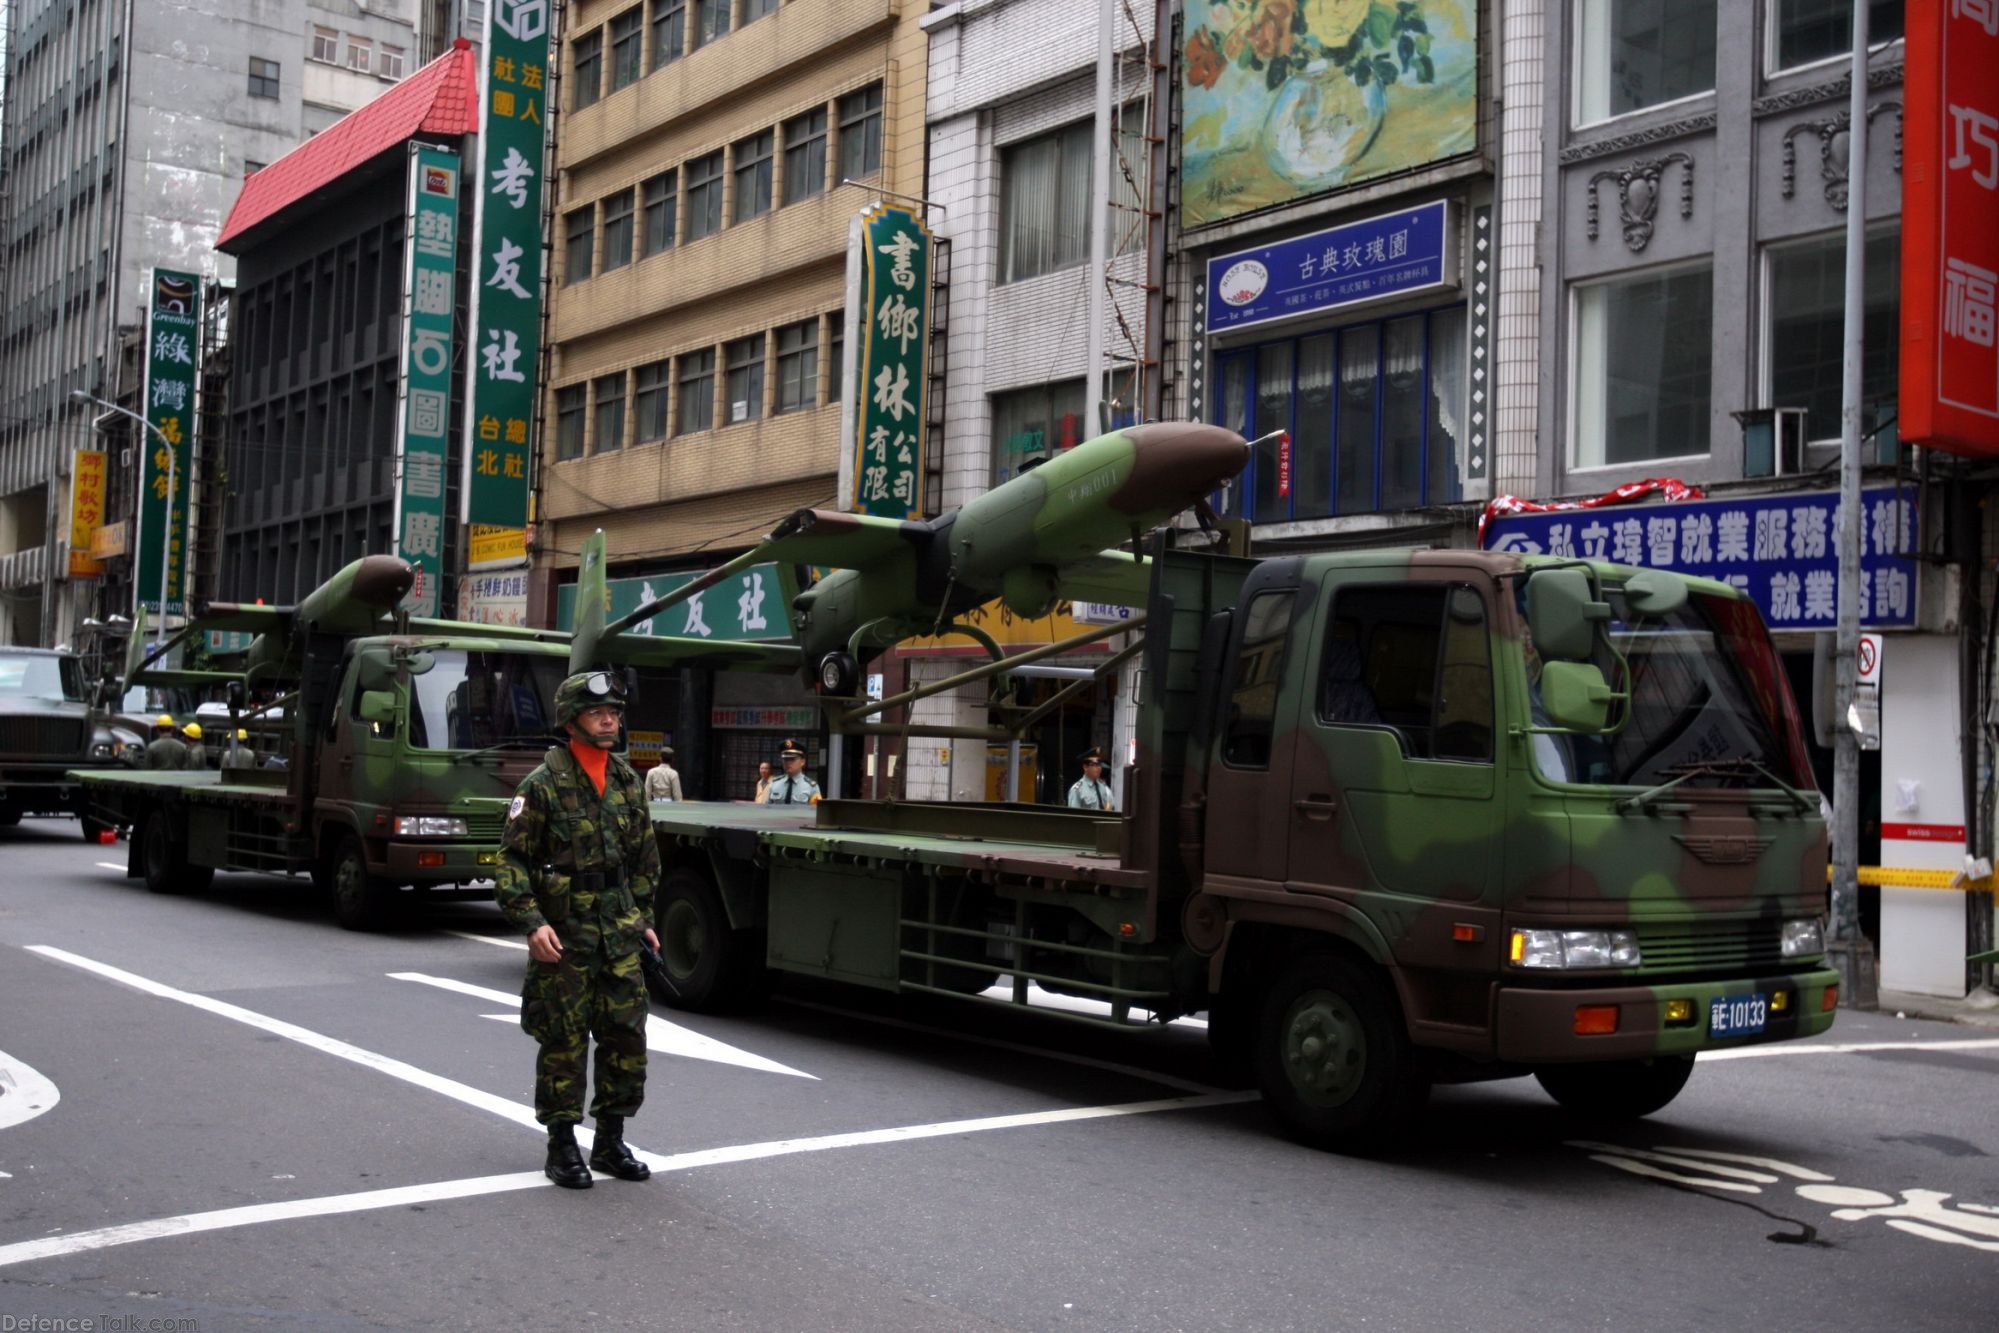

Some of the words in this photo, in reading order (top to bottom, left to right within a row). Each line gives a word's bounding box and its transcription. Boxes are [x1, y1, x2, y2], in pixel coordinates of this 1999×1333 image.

[482, 147, 535, 383] 考友社
[1298, 229, 1408, 280] 古典玫瑰園
[152, 311, 196, 328] Greenbay
[873, 230, 920, 422] 書鄉林
[152, 331, 192, 411] 綠灣
[476, 414, 501, 477] 台北
[504, 417, 528, 479] 總社
[864, 425, 890, 502] 有限
[893, 430, 917, 507] 公司
